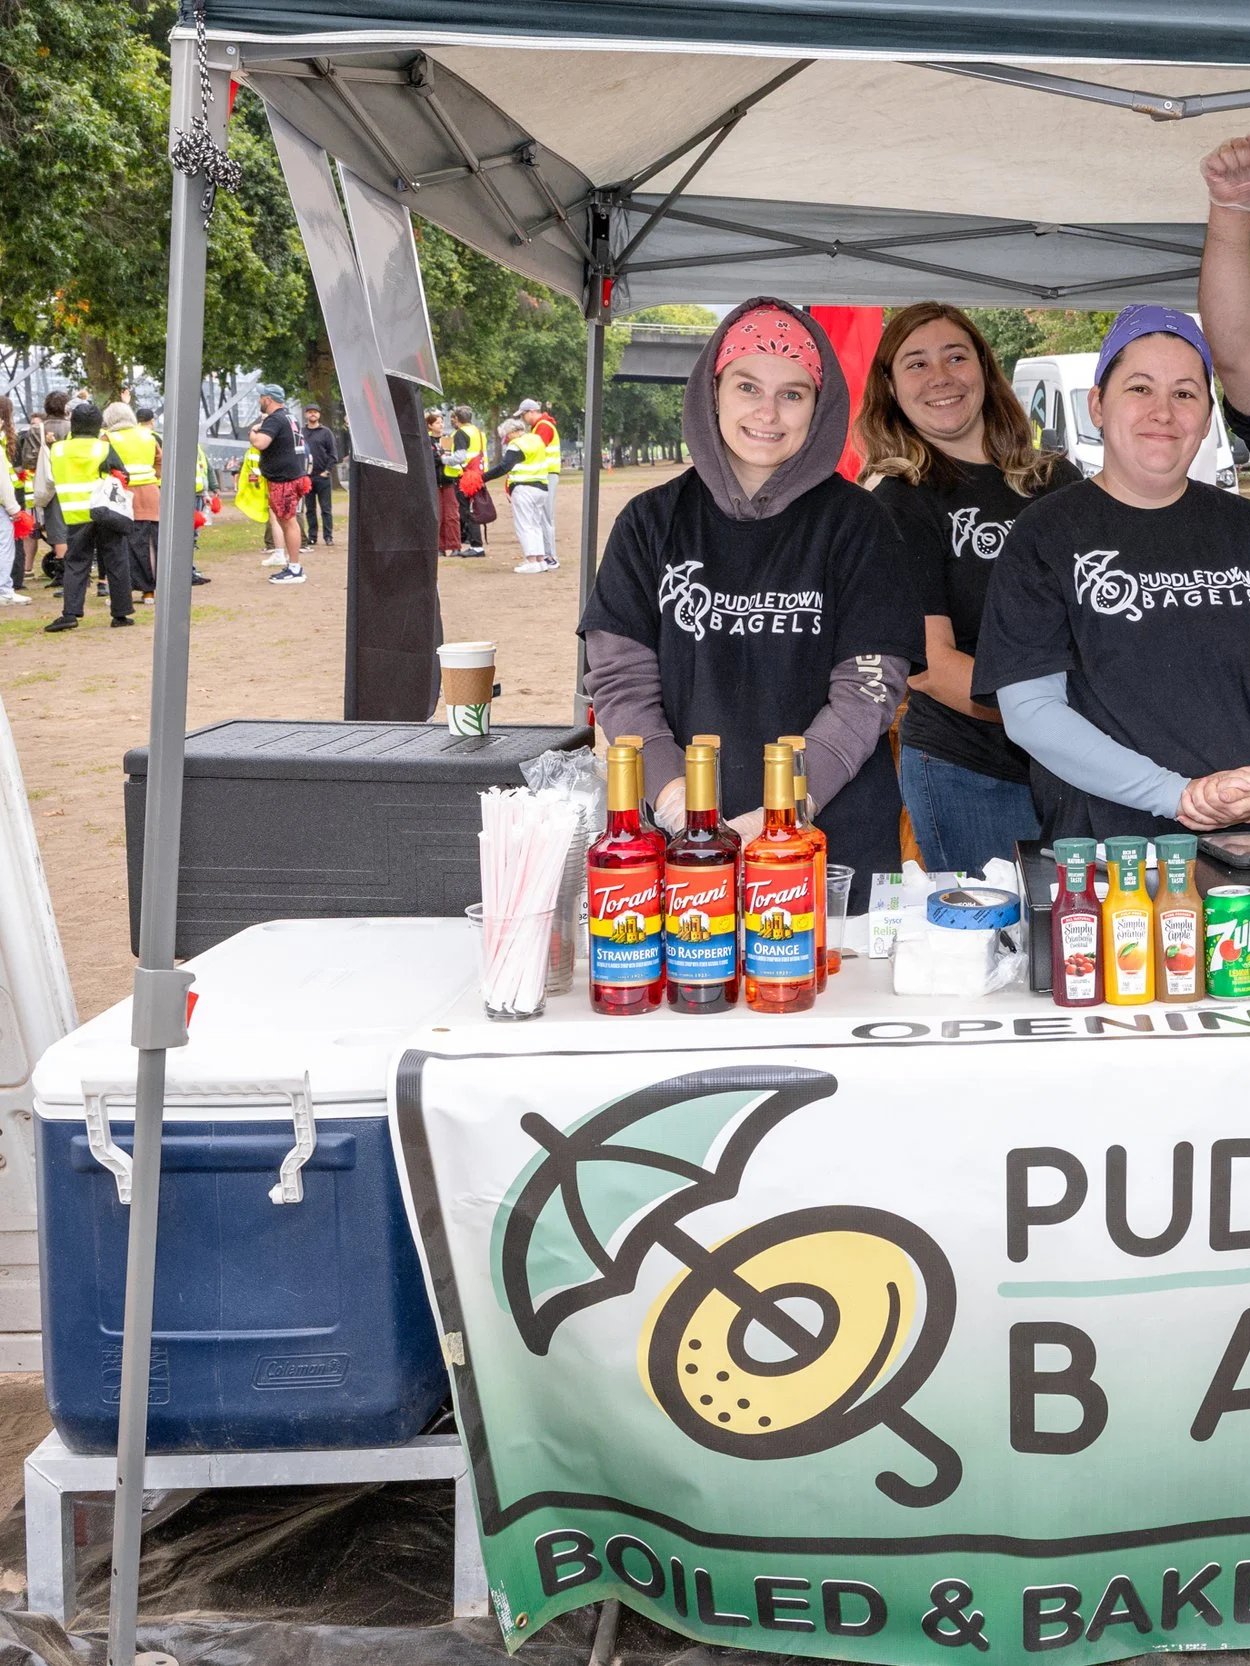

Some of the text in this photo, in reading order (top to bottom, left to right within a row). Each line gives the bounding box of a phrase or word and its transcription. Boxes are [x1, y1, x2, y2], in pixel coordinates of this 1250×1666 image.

[712, 590, 823, 609] PUDDLETOWN
[710, 612, 822, 636] BAGELS
[594, 879, 658, 921] Torani
[666, 879, 728, 917] Torani
[746, 877, 809, 916] Torani
[873, 926, 898, 936] Relia
[1064, 923, 1092, 936] Simply
[1164, 919, 1193, 931] Simply
[596, 946, 659, 961] STRAWBERRY
[678, 946, 733, 959] RASPBERRY
[754, 942, 800, 956] ORANGE
[266, 1360, 326, 1376] Coleman
[534, 1528, 888, 1638] BOILED
[920, 1577, 991, 1653] &
